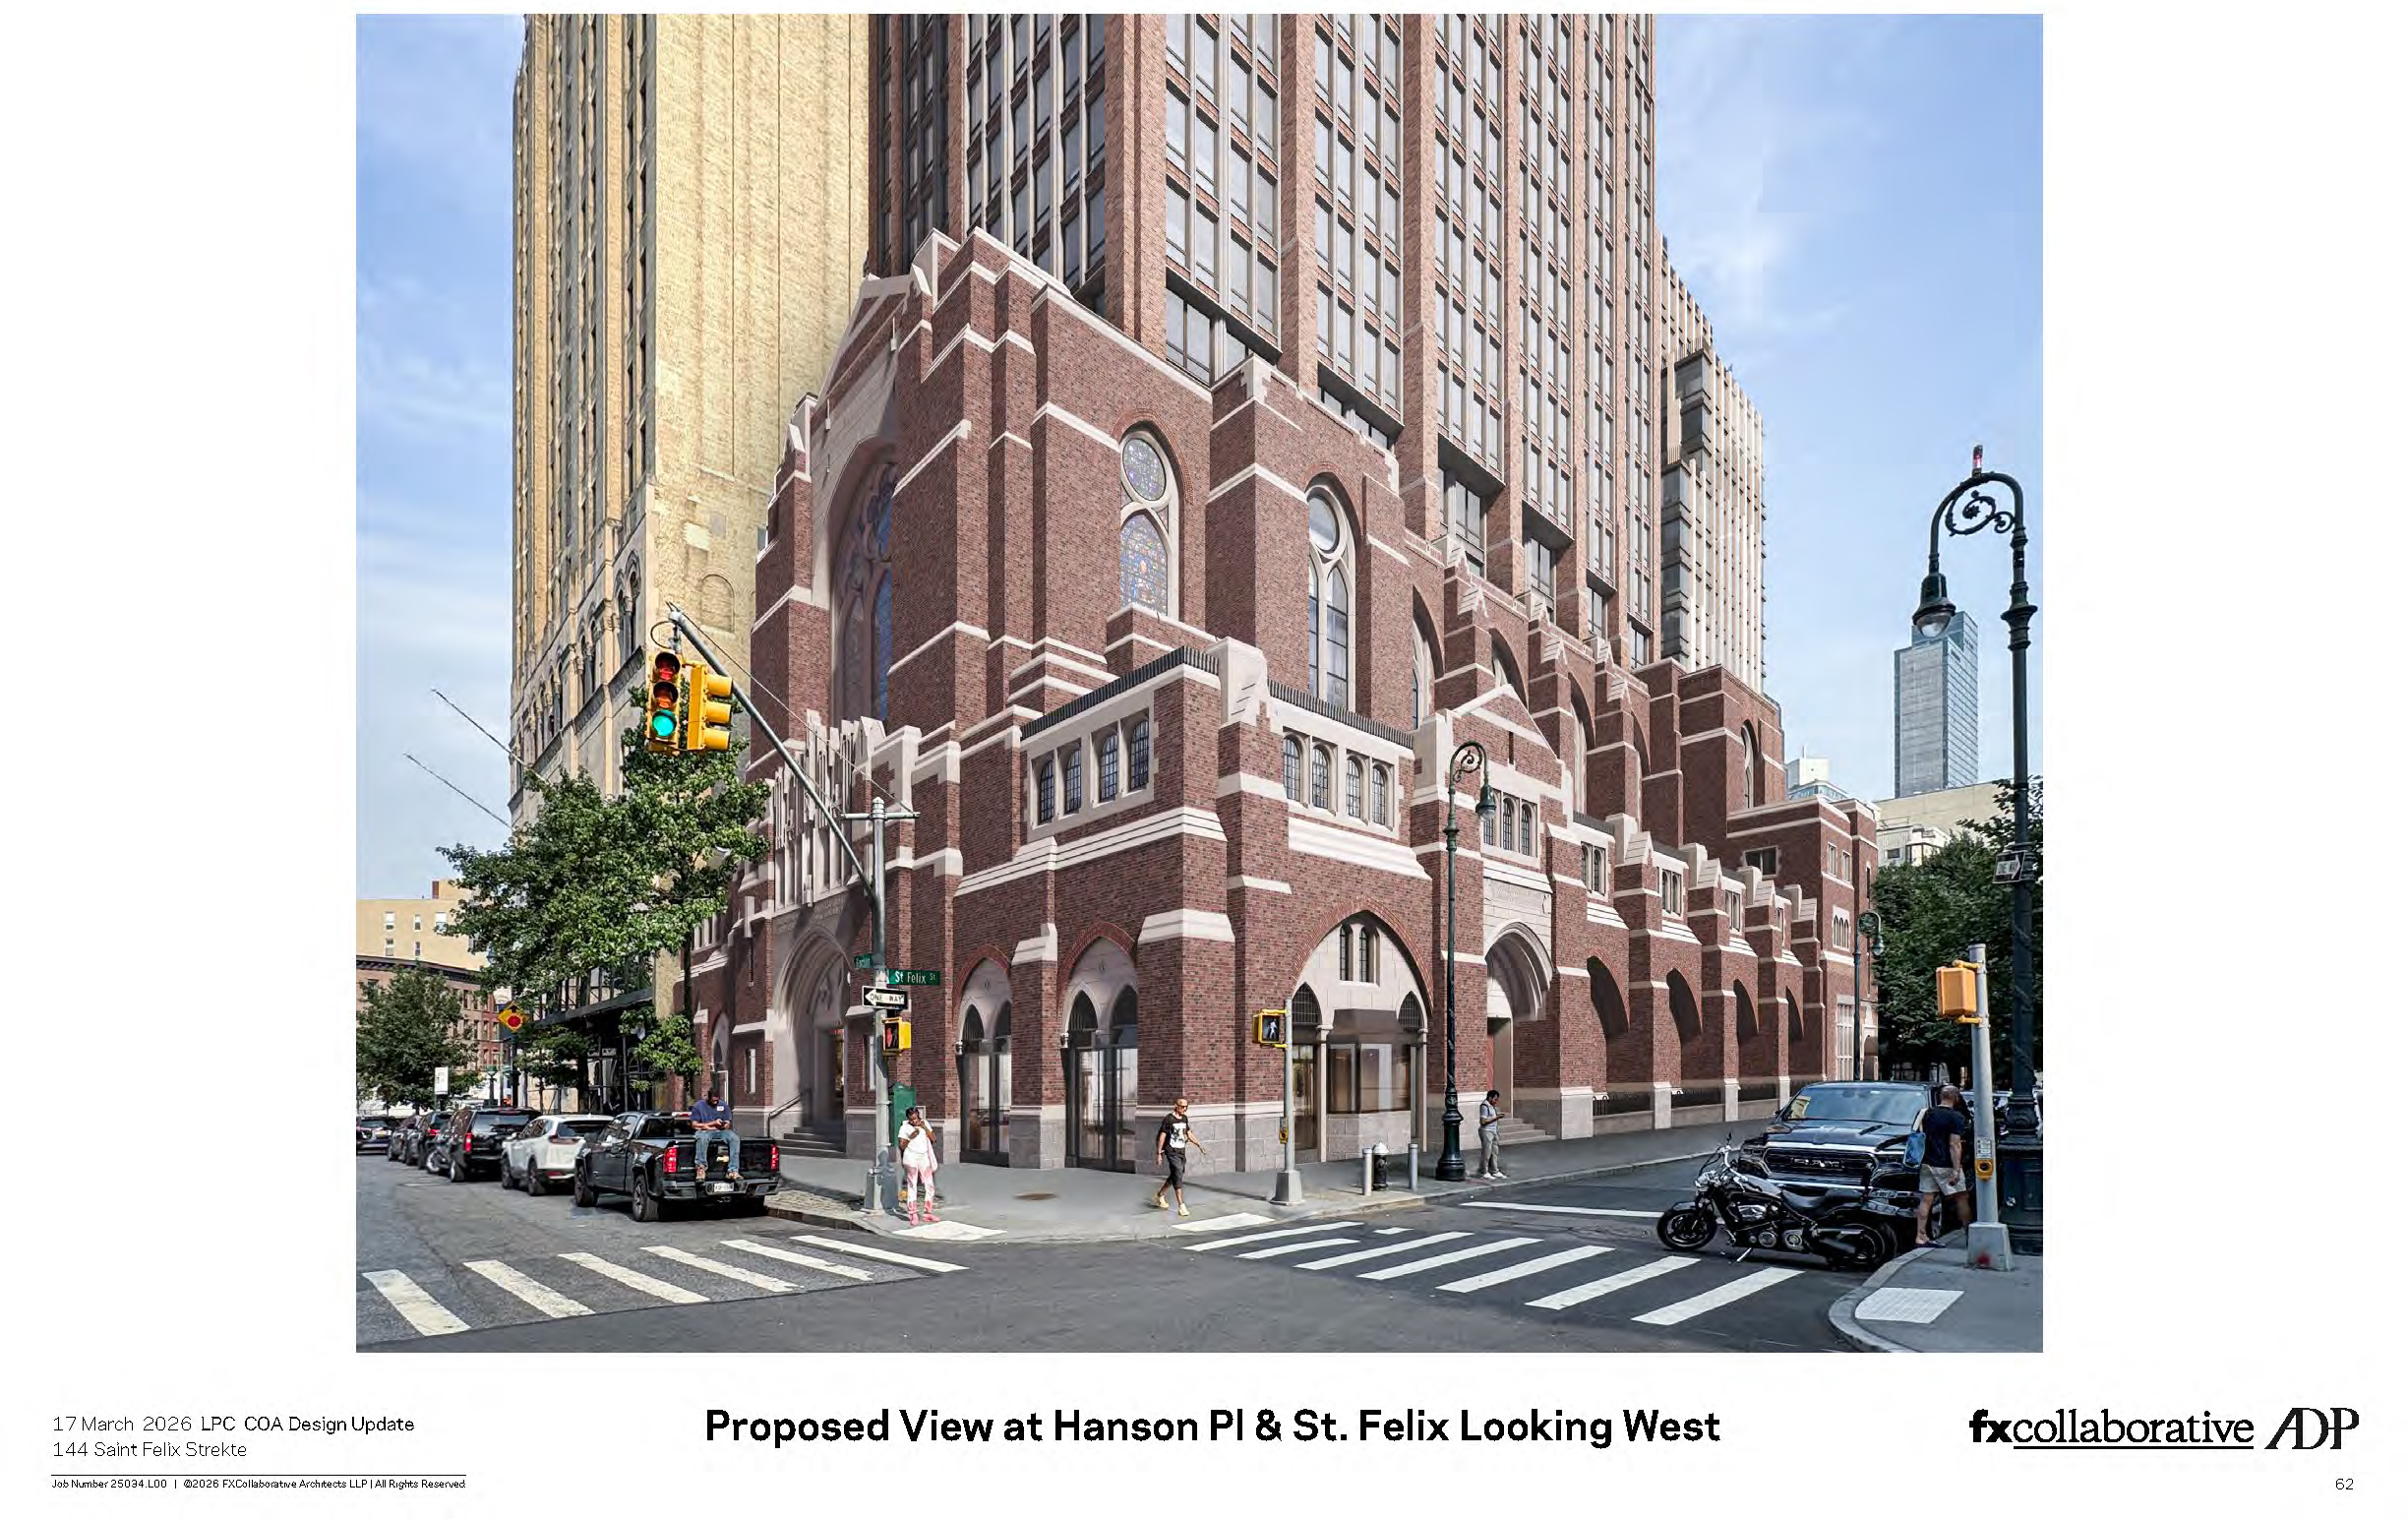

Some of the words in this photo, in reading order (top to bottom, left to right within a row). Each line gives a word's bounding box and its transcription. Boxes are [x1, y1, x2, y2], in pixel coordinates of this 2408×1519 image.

[895, 970, 904, 983] St
[907, 971, 927, 984] Felix
[929, 972, 936, 981] St
[870, 993, 883, 1002] ONE
